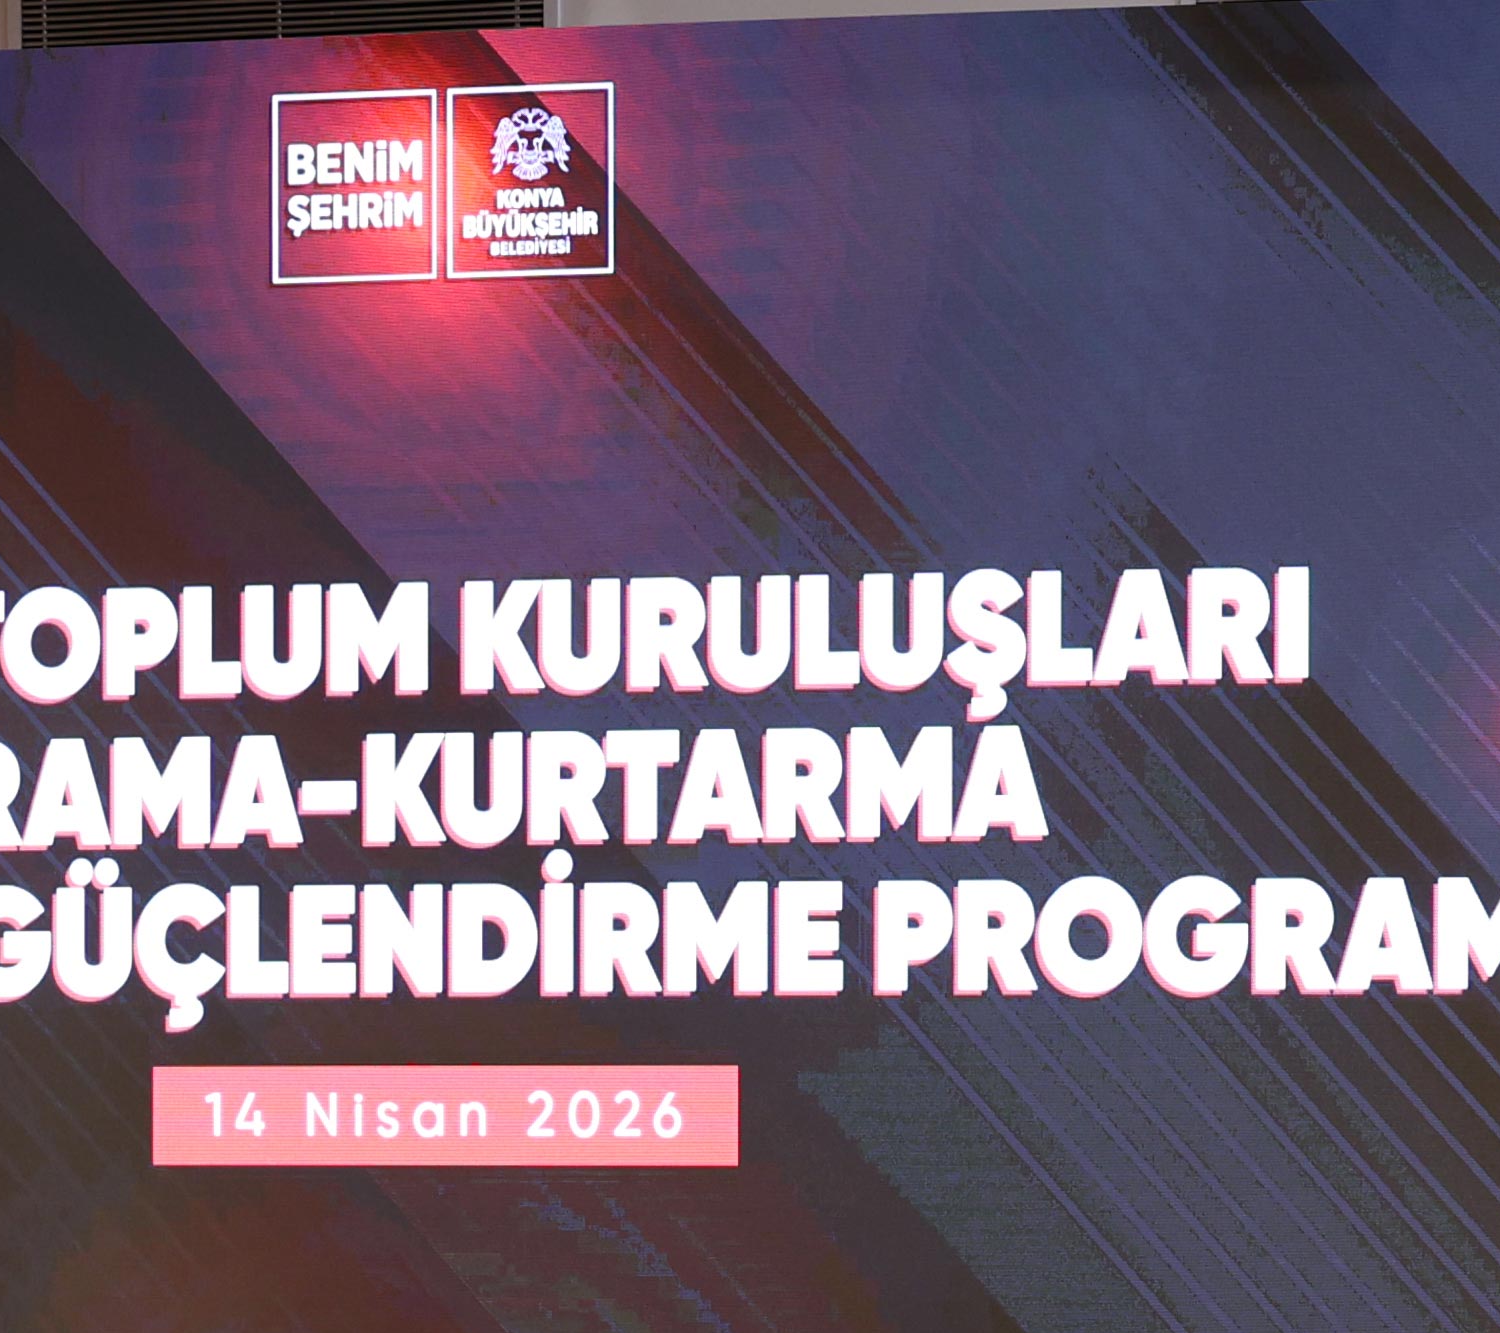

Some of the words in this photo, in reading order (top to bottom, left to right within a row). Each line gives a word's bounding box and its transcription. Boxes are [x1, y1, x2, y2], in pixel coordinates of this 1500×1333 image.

[496, 187, 566, 209] KONYA
[462, 206, 599, 240] BÜYÜKŞEHİR
[460, 565, 1310, 722] KURULUŞLARI
[204, 1092, 267, 1137] 14
[306, 1092, 488, 1138] Nisan
[526, 1090, 683, 1138] 2026
